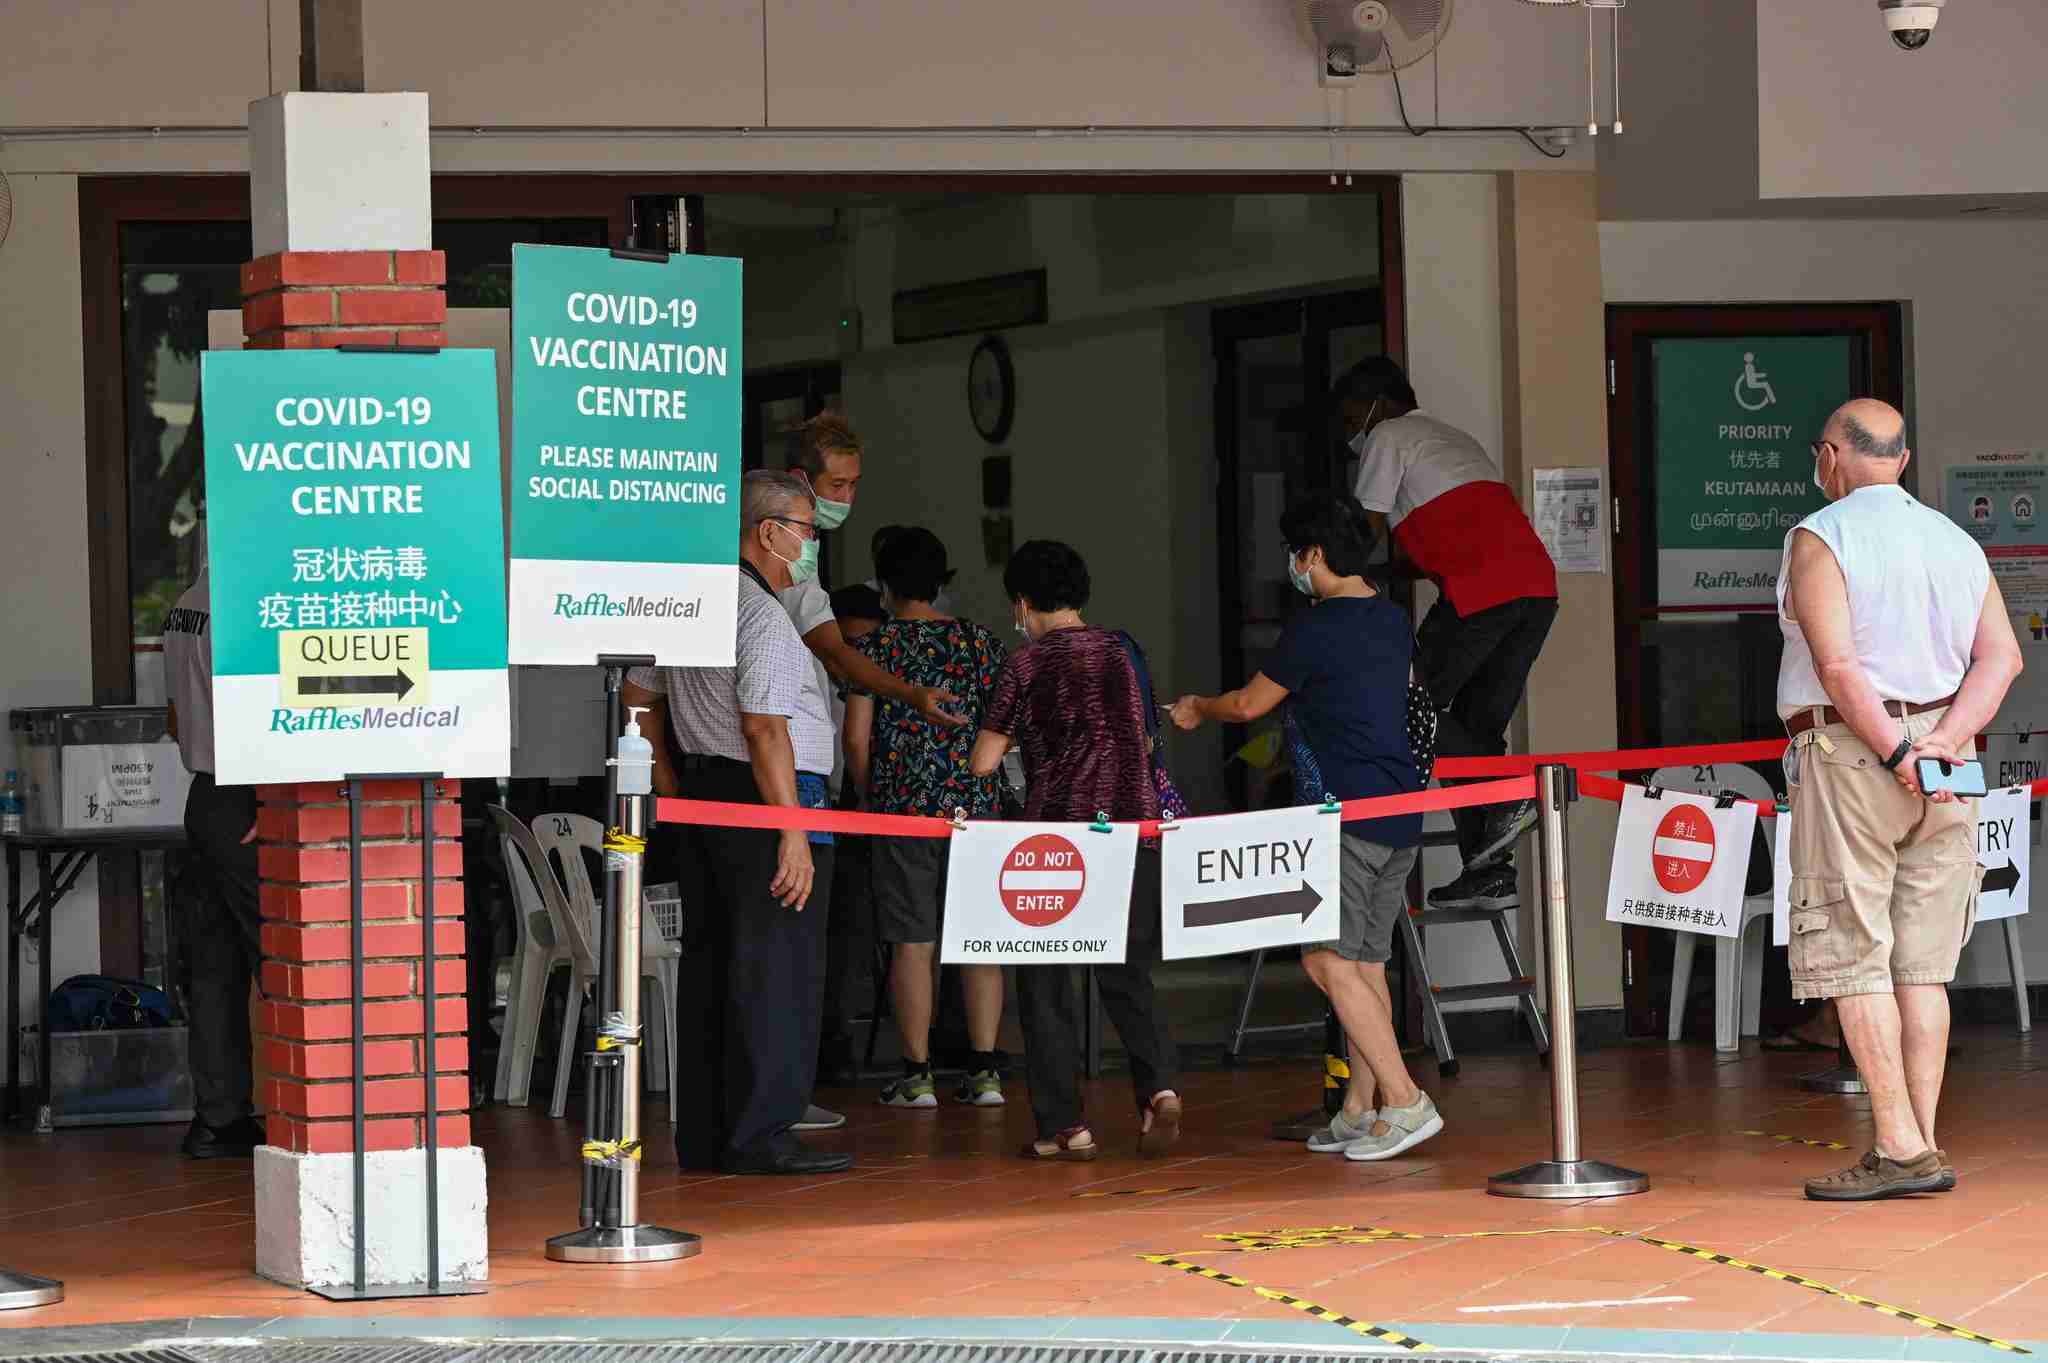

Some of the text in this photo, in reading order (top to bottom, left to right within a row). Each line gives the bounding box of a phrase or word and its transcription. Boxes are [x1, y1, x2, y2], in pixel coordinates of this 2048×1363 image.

[567, 292, 697, 328] COVID-19
[530, 336, 727, 376] VACCINATION
[275, 397, 432, 426] COVID-19
[577, 385, 687, 420] CENTRE
[1719, 425, 1792, 439] PRIORITY
[234, 440, 471, 471] VACCINATION
[540, 445, 718, 473] PLEASE MAINTAIN
[1729, 450, 1782, 469] 优先者
[291, 485, 424, 515] CENTRE
[529, 476, 726, 504] SOCIAL DISTANCING
[1705, 481, 1806, 496] KEUTAMAAN
[292, 545, 428, 583] 冠状病毒
[1693, 570, 1777, 590] RafflesMe
[258, 590, 463, 629] 疫苗接种中心
[553, 593, 701, 619] RafflesMedical
[301, 634, 411, 664] QUEUE
[268, 706, 461, 734] RafflesMedical
[1694, 764, 1716, 782] 21
[552, 817, 573, 837] 24
[1672, 820, 1698, 840] 禁止
[1977, 817, 2015, 853] TRY
[1014, 851, 1074, 867] DO NOT
[1196, 838, 1314, 884] ENTRY
[1666, 860, 1691, 879] 进入
[1016, 895, 1064, 911] ENTER
[1622, 899, 1727, 928] 只供疫苗接种者进入
[963, 939, 1108, 953] FOR VACCINEES ONLY
